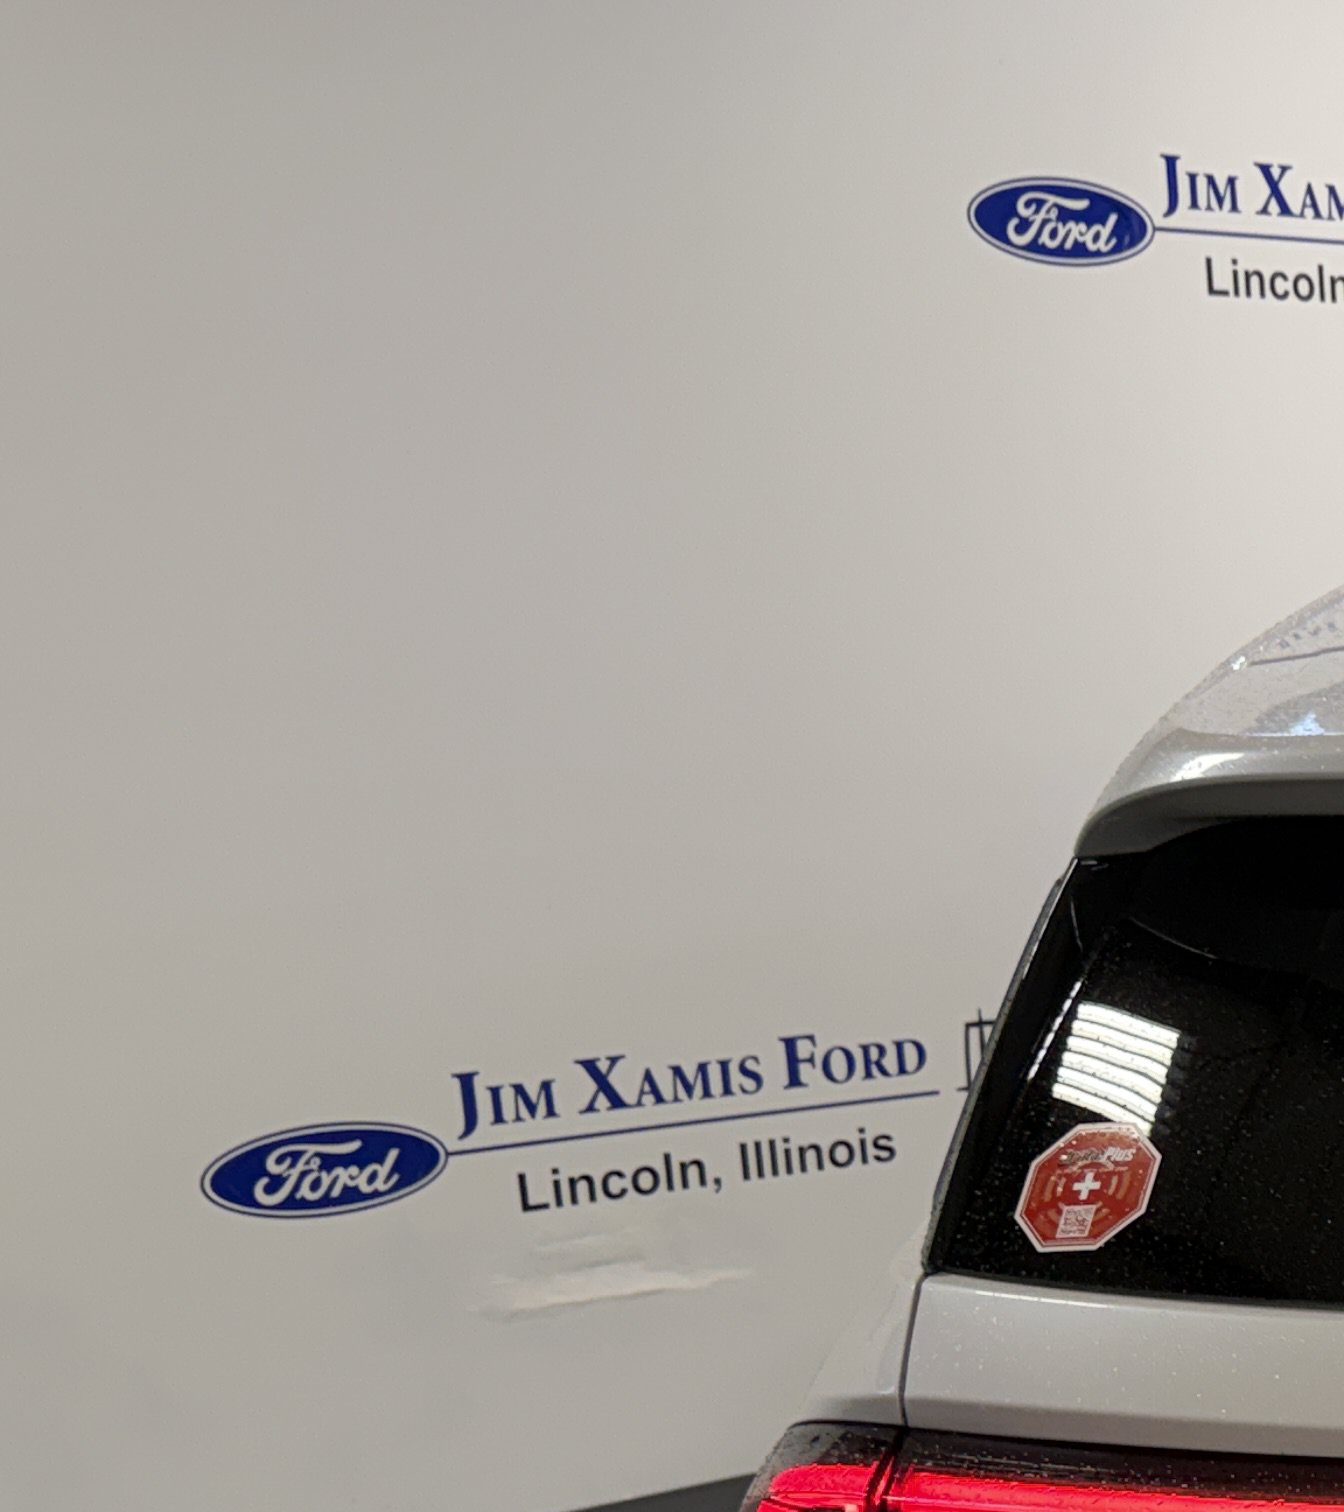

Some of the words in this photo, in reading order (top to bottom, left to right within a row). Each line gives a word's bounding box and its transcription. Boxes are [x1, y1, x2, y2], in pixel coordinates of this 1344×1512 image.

[1161, 154, 1240, 217] JIM
[1006, 190, 1117, 253] Ford
[451, 1072, 560, 1142] JIM
[575, 1055, 764, 1115] XAMIS
[779, 1035, 926, 1089] FORD
[254, 1141, 399, 1206] Ford
[517, 1149, 722, 1213] Lincoln,
[740, 1128, 896, 1180] Illinois
